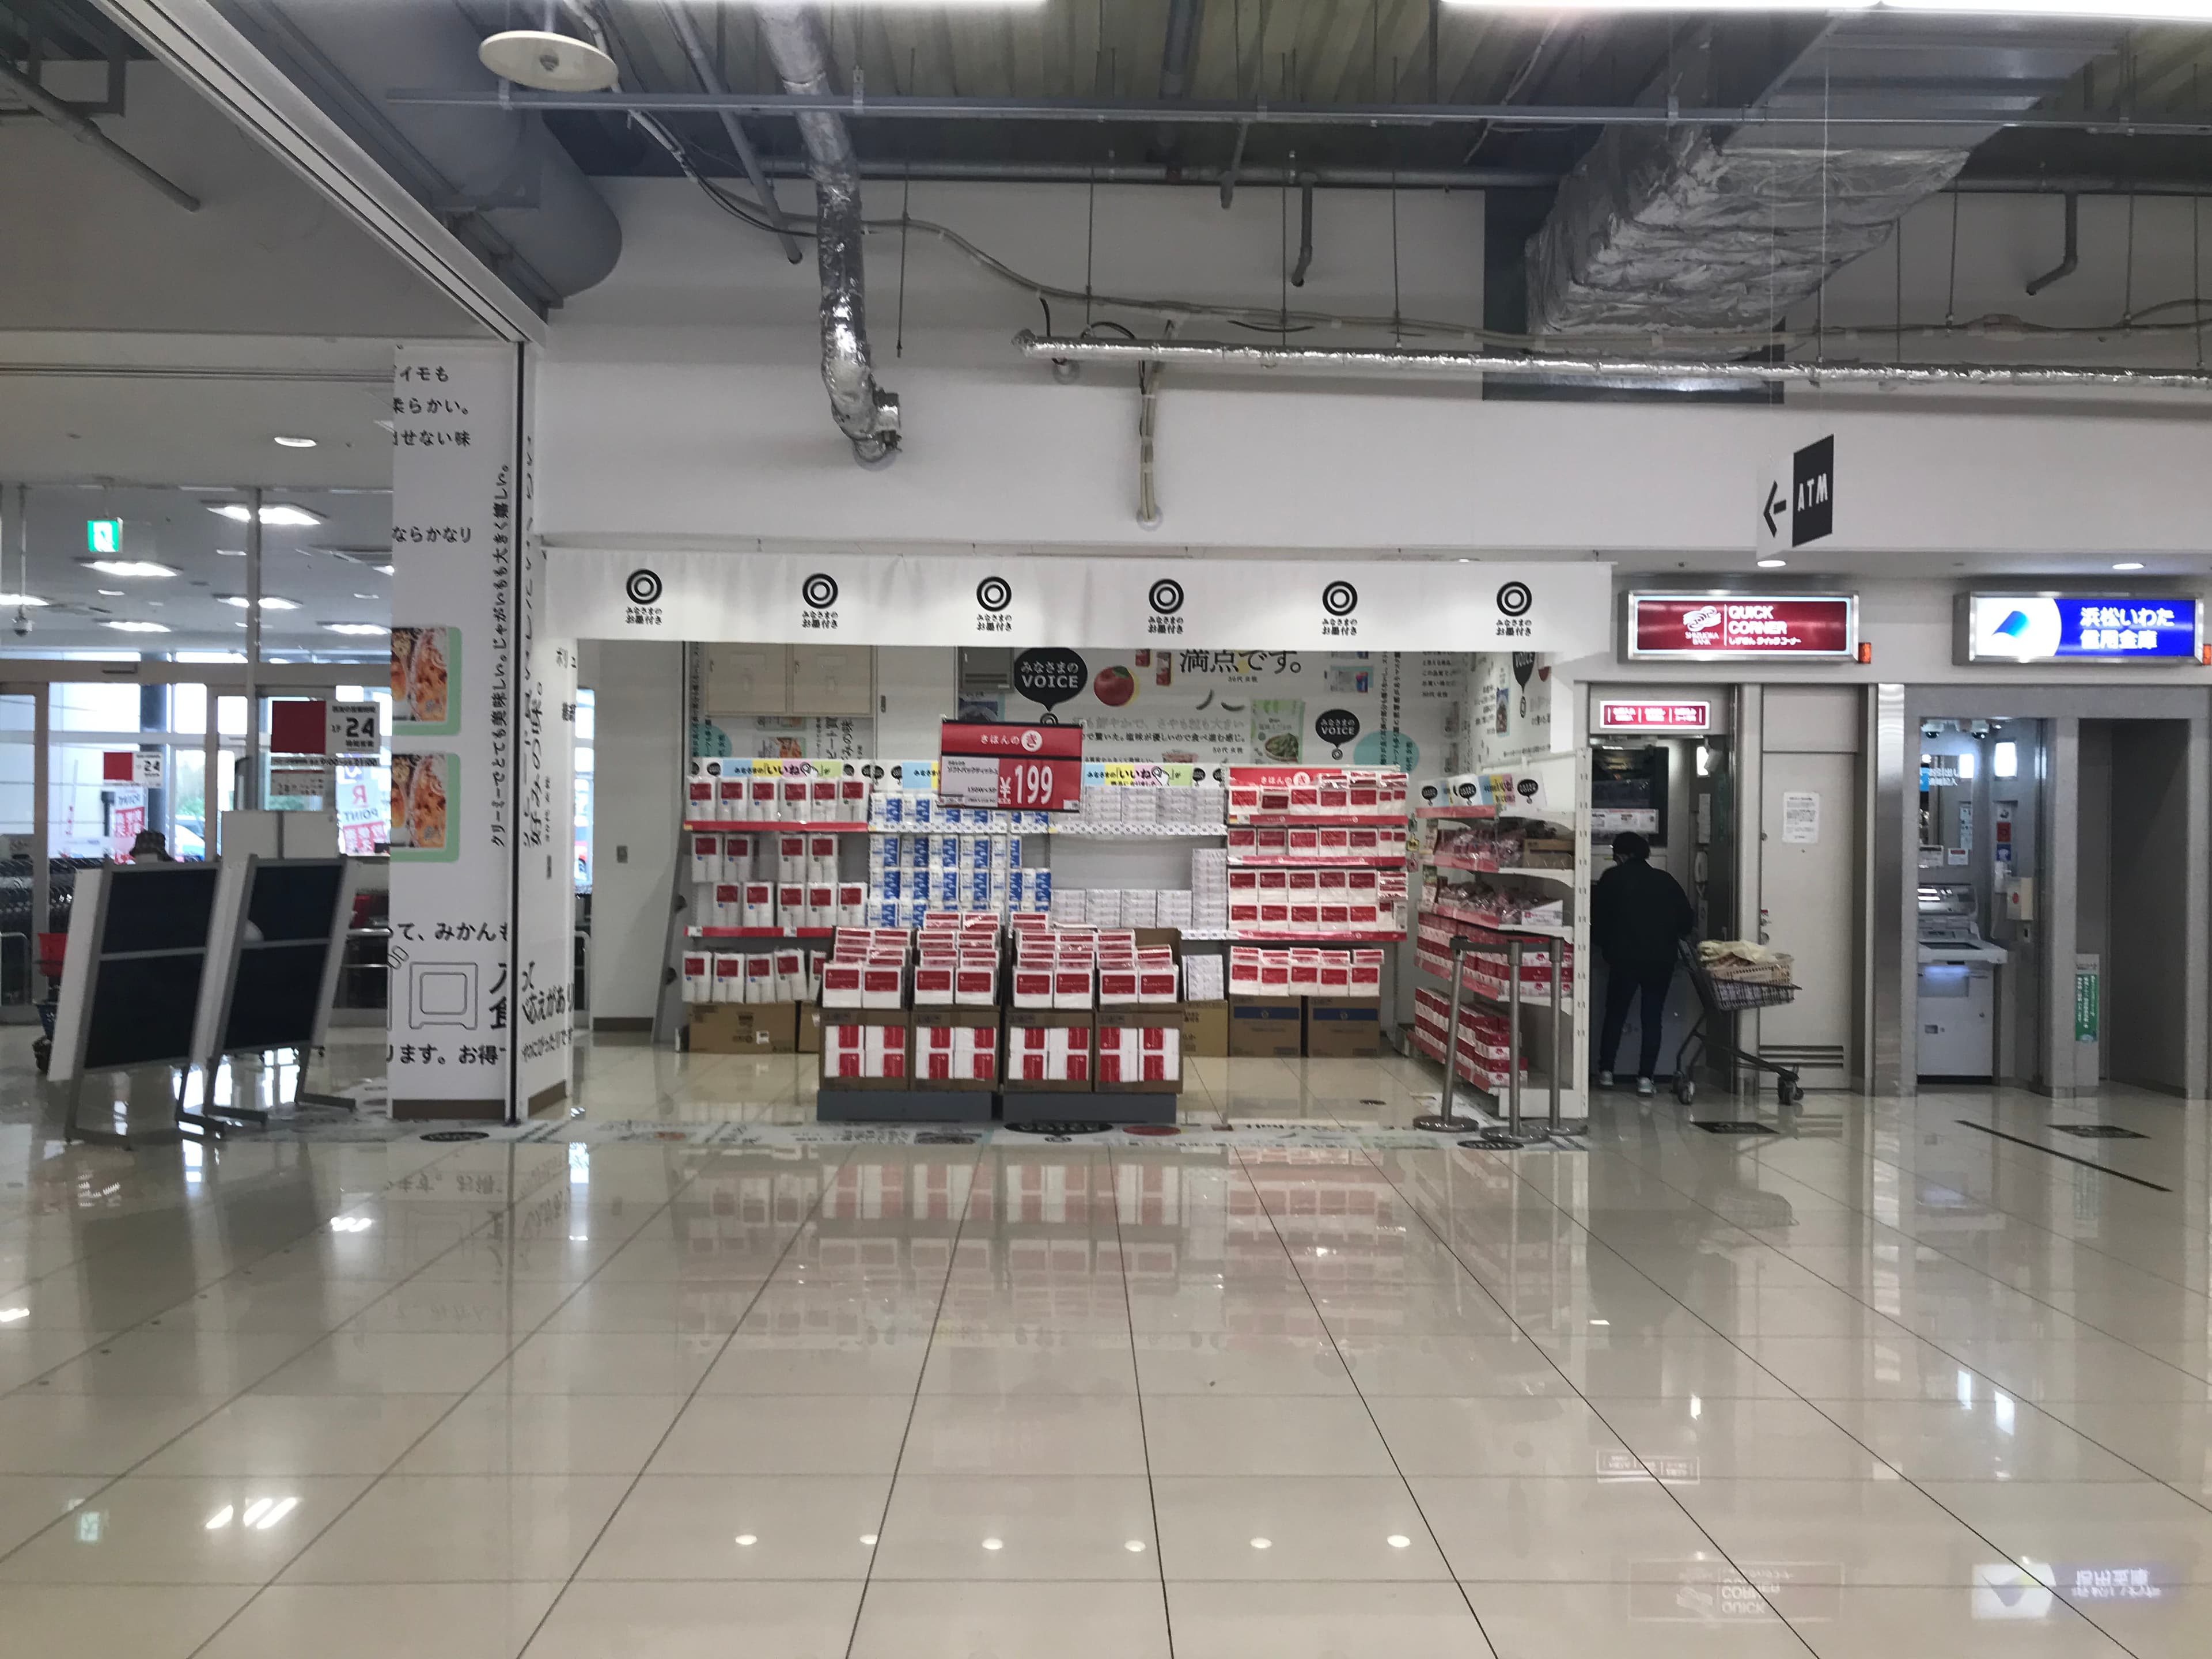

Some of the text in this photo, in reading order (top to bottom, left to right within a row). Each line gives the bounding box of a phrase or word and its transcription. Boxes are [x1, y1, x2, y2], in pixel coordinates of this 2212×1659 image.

[394, 365, 449, 382] イモも
[1798, 473, 1828, 512] ATM
[1729, 605, 1774, 619] QUICK
[2080, 607, 2175, 627] 浜松いわた
[1728, 621, 1787, 635] CORNER
[2080, 630, 2158, 650] 信用金庫
[1021, 661, 1079, 674] みなさまの
[1180, 650, 1301, 674] 満点です。
[1022, 675, 1079, 688] VOICE
[346, 718, 374, 737] 24
[1321, 727, 1355, 735] VOICE
